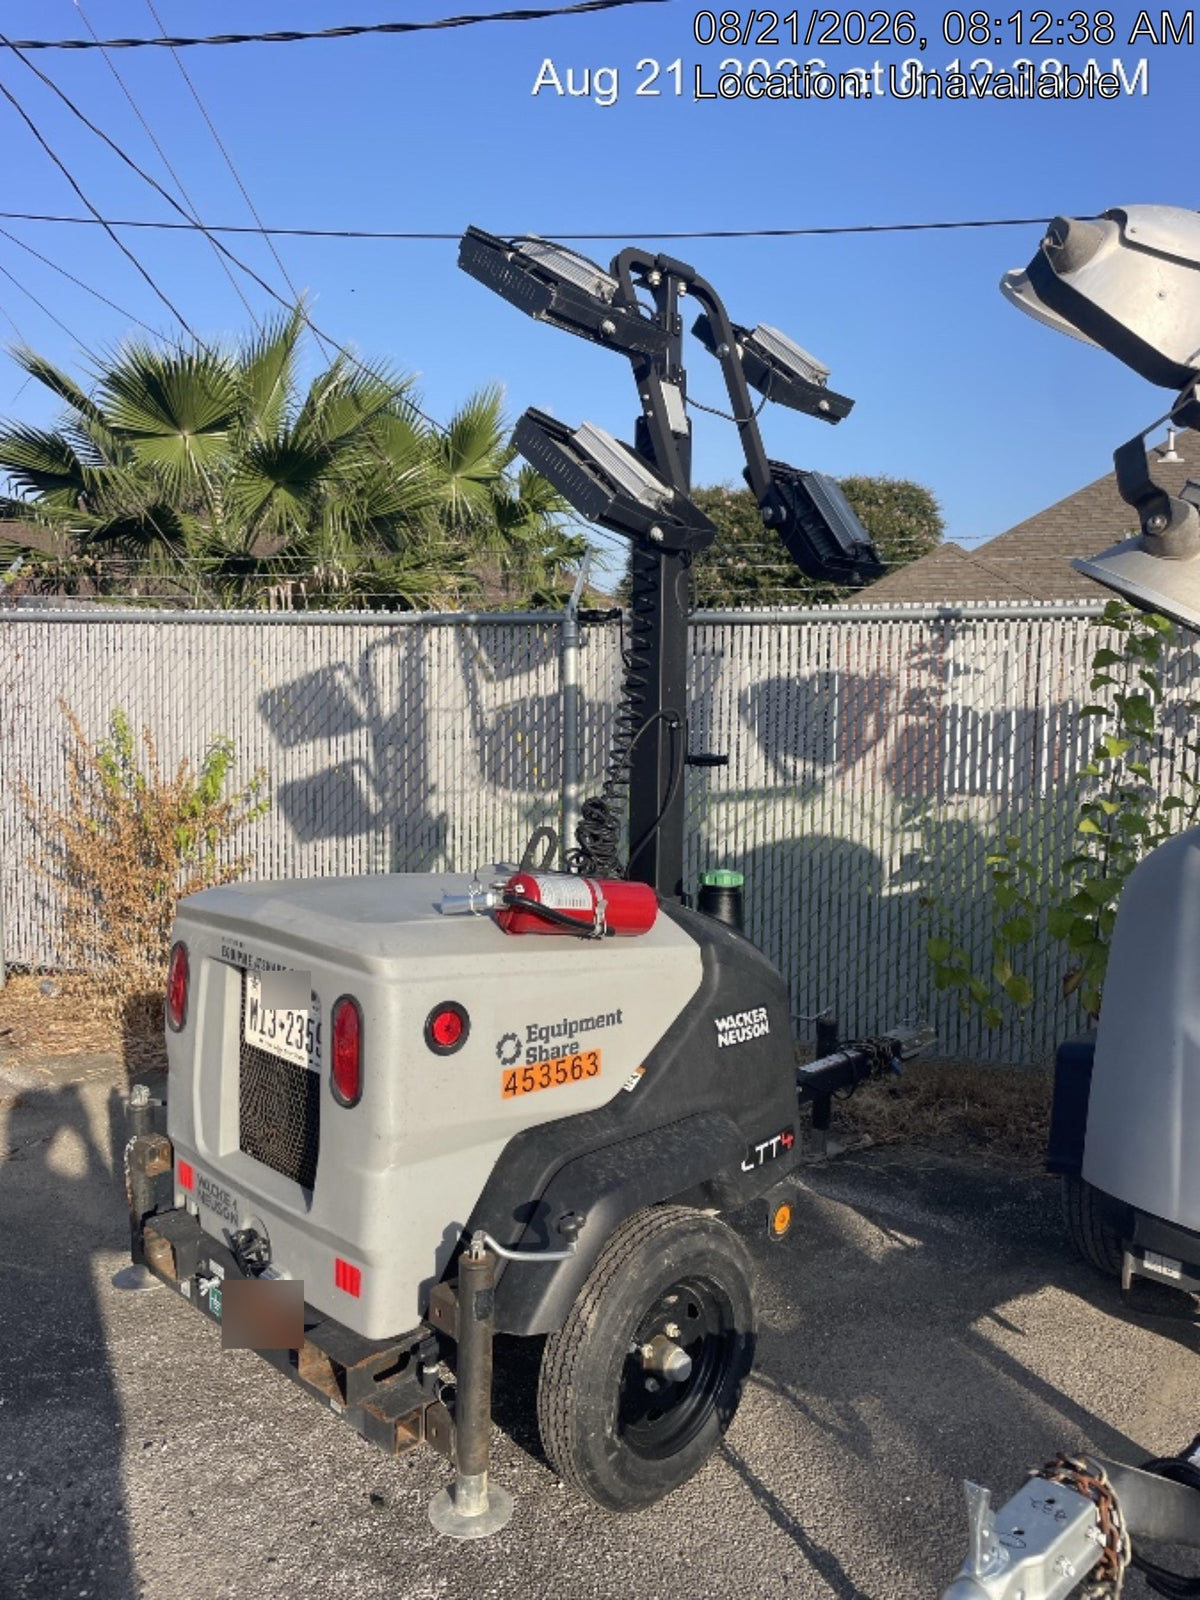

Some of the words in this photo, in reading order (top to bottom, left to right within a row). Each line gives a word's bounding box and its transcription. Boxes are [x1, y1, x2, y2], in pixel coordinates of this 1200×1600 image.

[526, 1009, 623, 1044] Equipment
[714, 1007, 768, 1032] WACKER
[717, 1020, 770, 1048] NEUSON
[525, 1041, 580, 1066] Share
[504, 1051, 600, 1096] 453563
